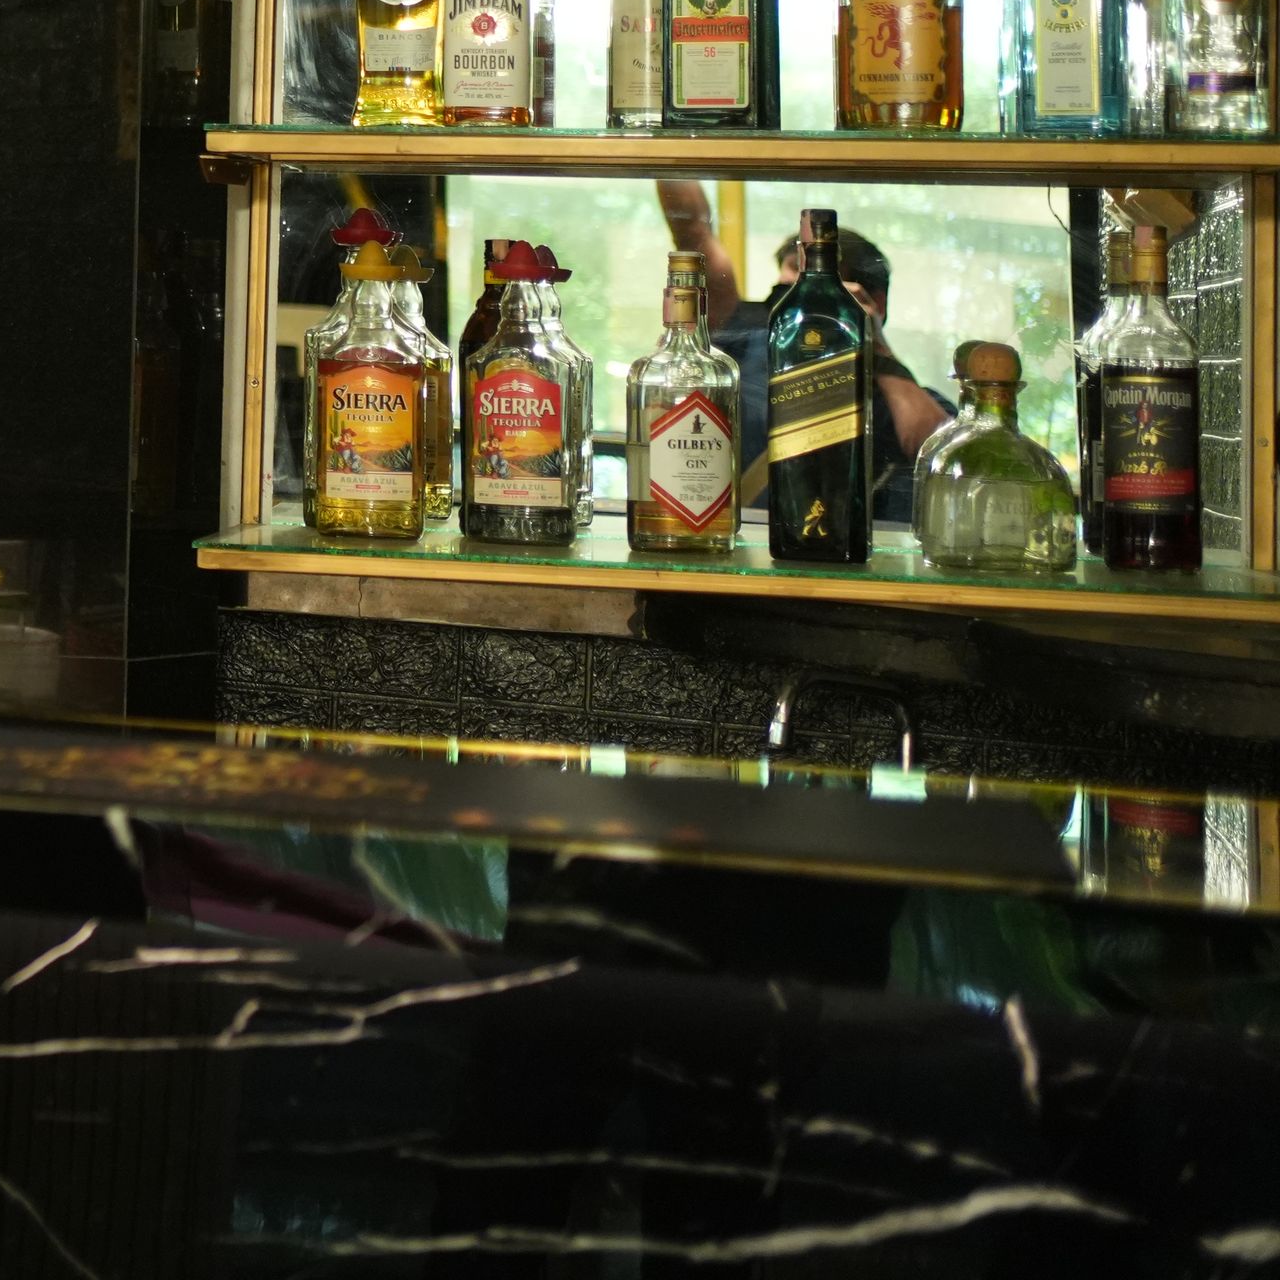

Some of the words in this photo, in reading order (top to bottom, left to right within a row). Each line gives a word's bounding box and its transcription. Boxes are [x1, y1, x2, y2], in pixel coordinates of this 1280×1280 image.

[378, 33, 423, 41] BIANCO
[703, 46, 716, 58] 56
[454, 55, 515, 70] BOURBON
[770, 385, 815, 405] DOUBLE
[817, 373, 857, 390] BLACK
[332, 384, 408, 412] SIERRA
[480, 388, 556, 418] SIERRA
[1104, 386, 1143, 408] Captain
[1143, 385, 1192, 409] Morgan
[346, 413, 394, 422] TEQUILA
[493, 418, 541, 427] TEQUILA
[667, 438, 723, 451] GILBEY'S
[686, 460, 708, 469] GIN
